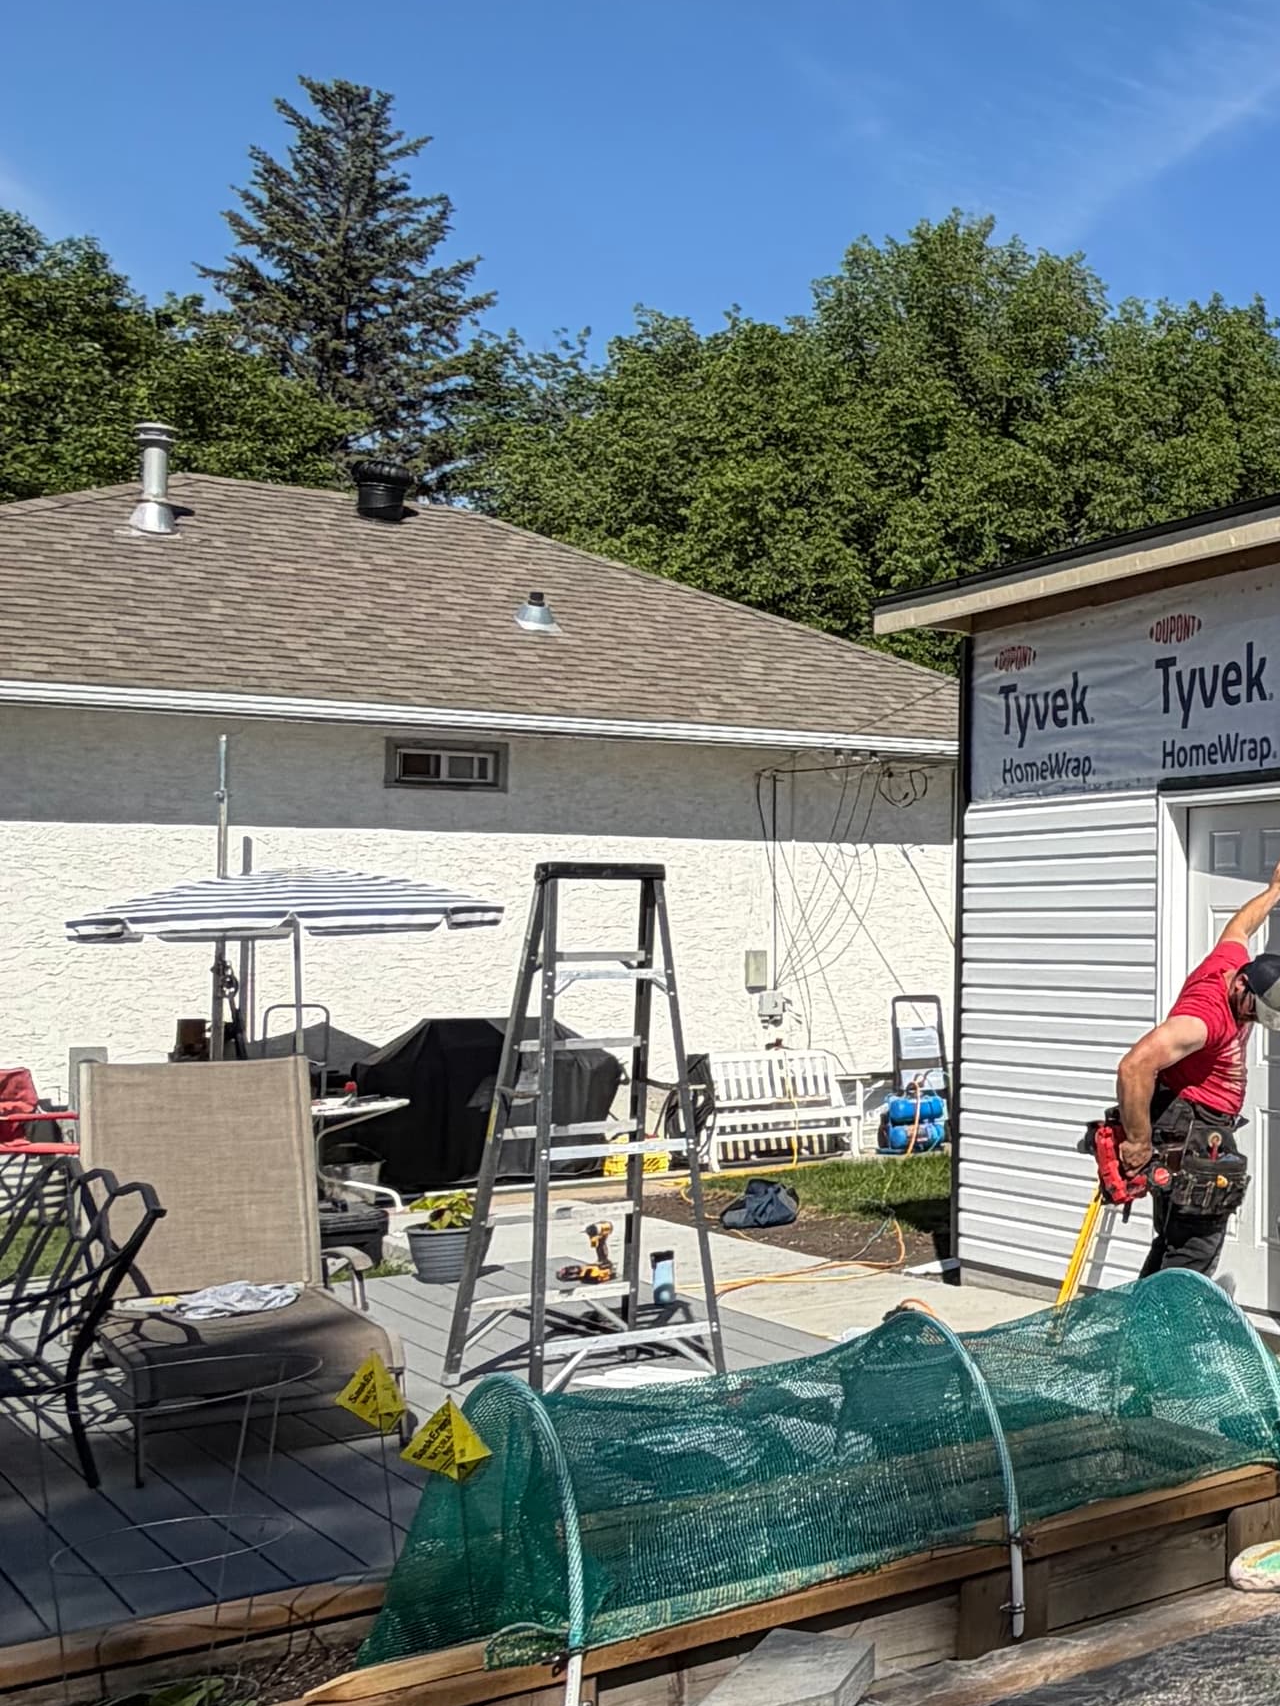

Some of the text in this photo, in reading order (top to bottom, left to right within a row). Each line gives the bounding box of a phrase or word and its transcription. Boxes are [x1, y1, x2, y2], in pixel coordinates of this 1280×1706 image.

[1155, 613, 1197, 644] DUPONT
[1000, 645, 1033, 672] DUPONT
[1155, 641, 1268, 729] Tyvek
[998, 671, 1090, 749] Tyvek
[1002, 751, 1093, 784] HomeWrap
[1162, 732, 1272, 770] HomeWrap
